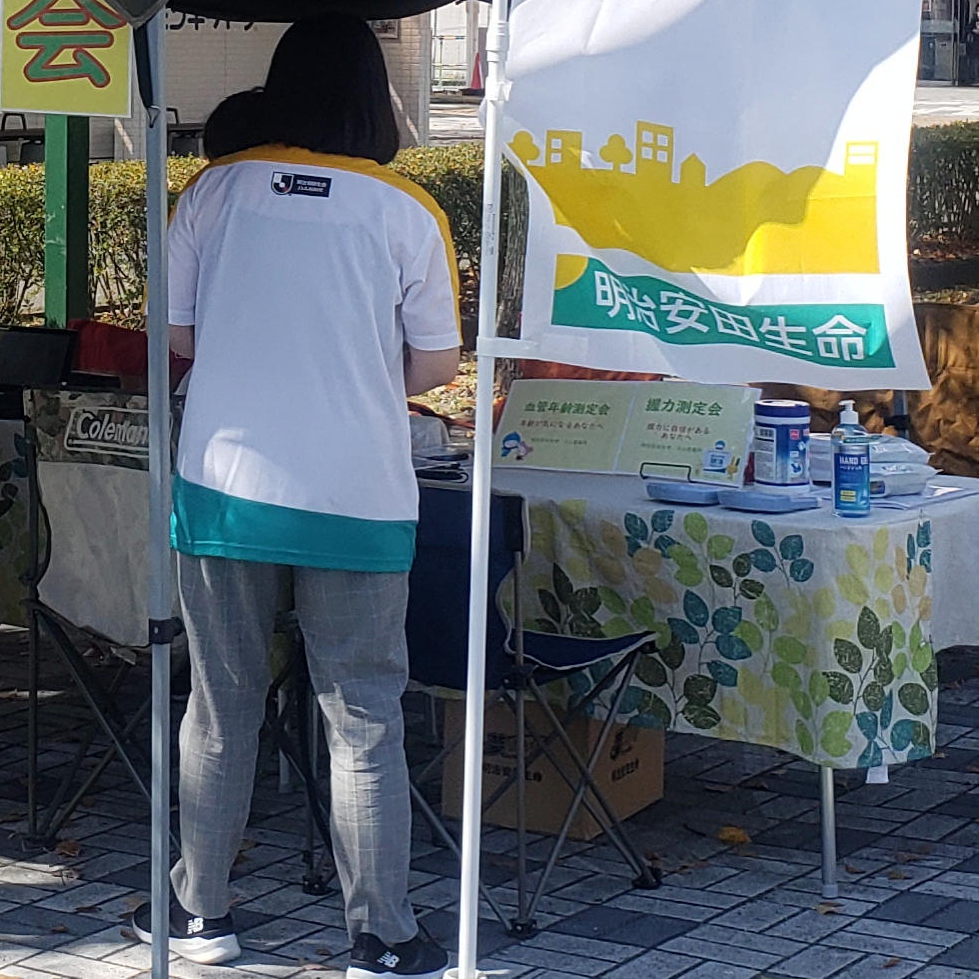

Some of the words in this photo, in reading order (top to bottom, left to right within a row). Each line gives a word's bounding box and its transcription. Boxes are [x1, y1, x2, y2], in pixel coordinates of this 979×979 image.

[594, 270, 868, 362] 明治安田生命
[77, 412, 149, 446] Coleman
